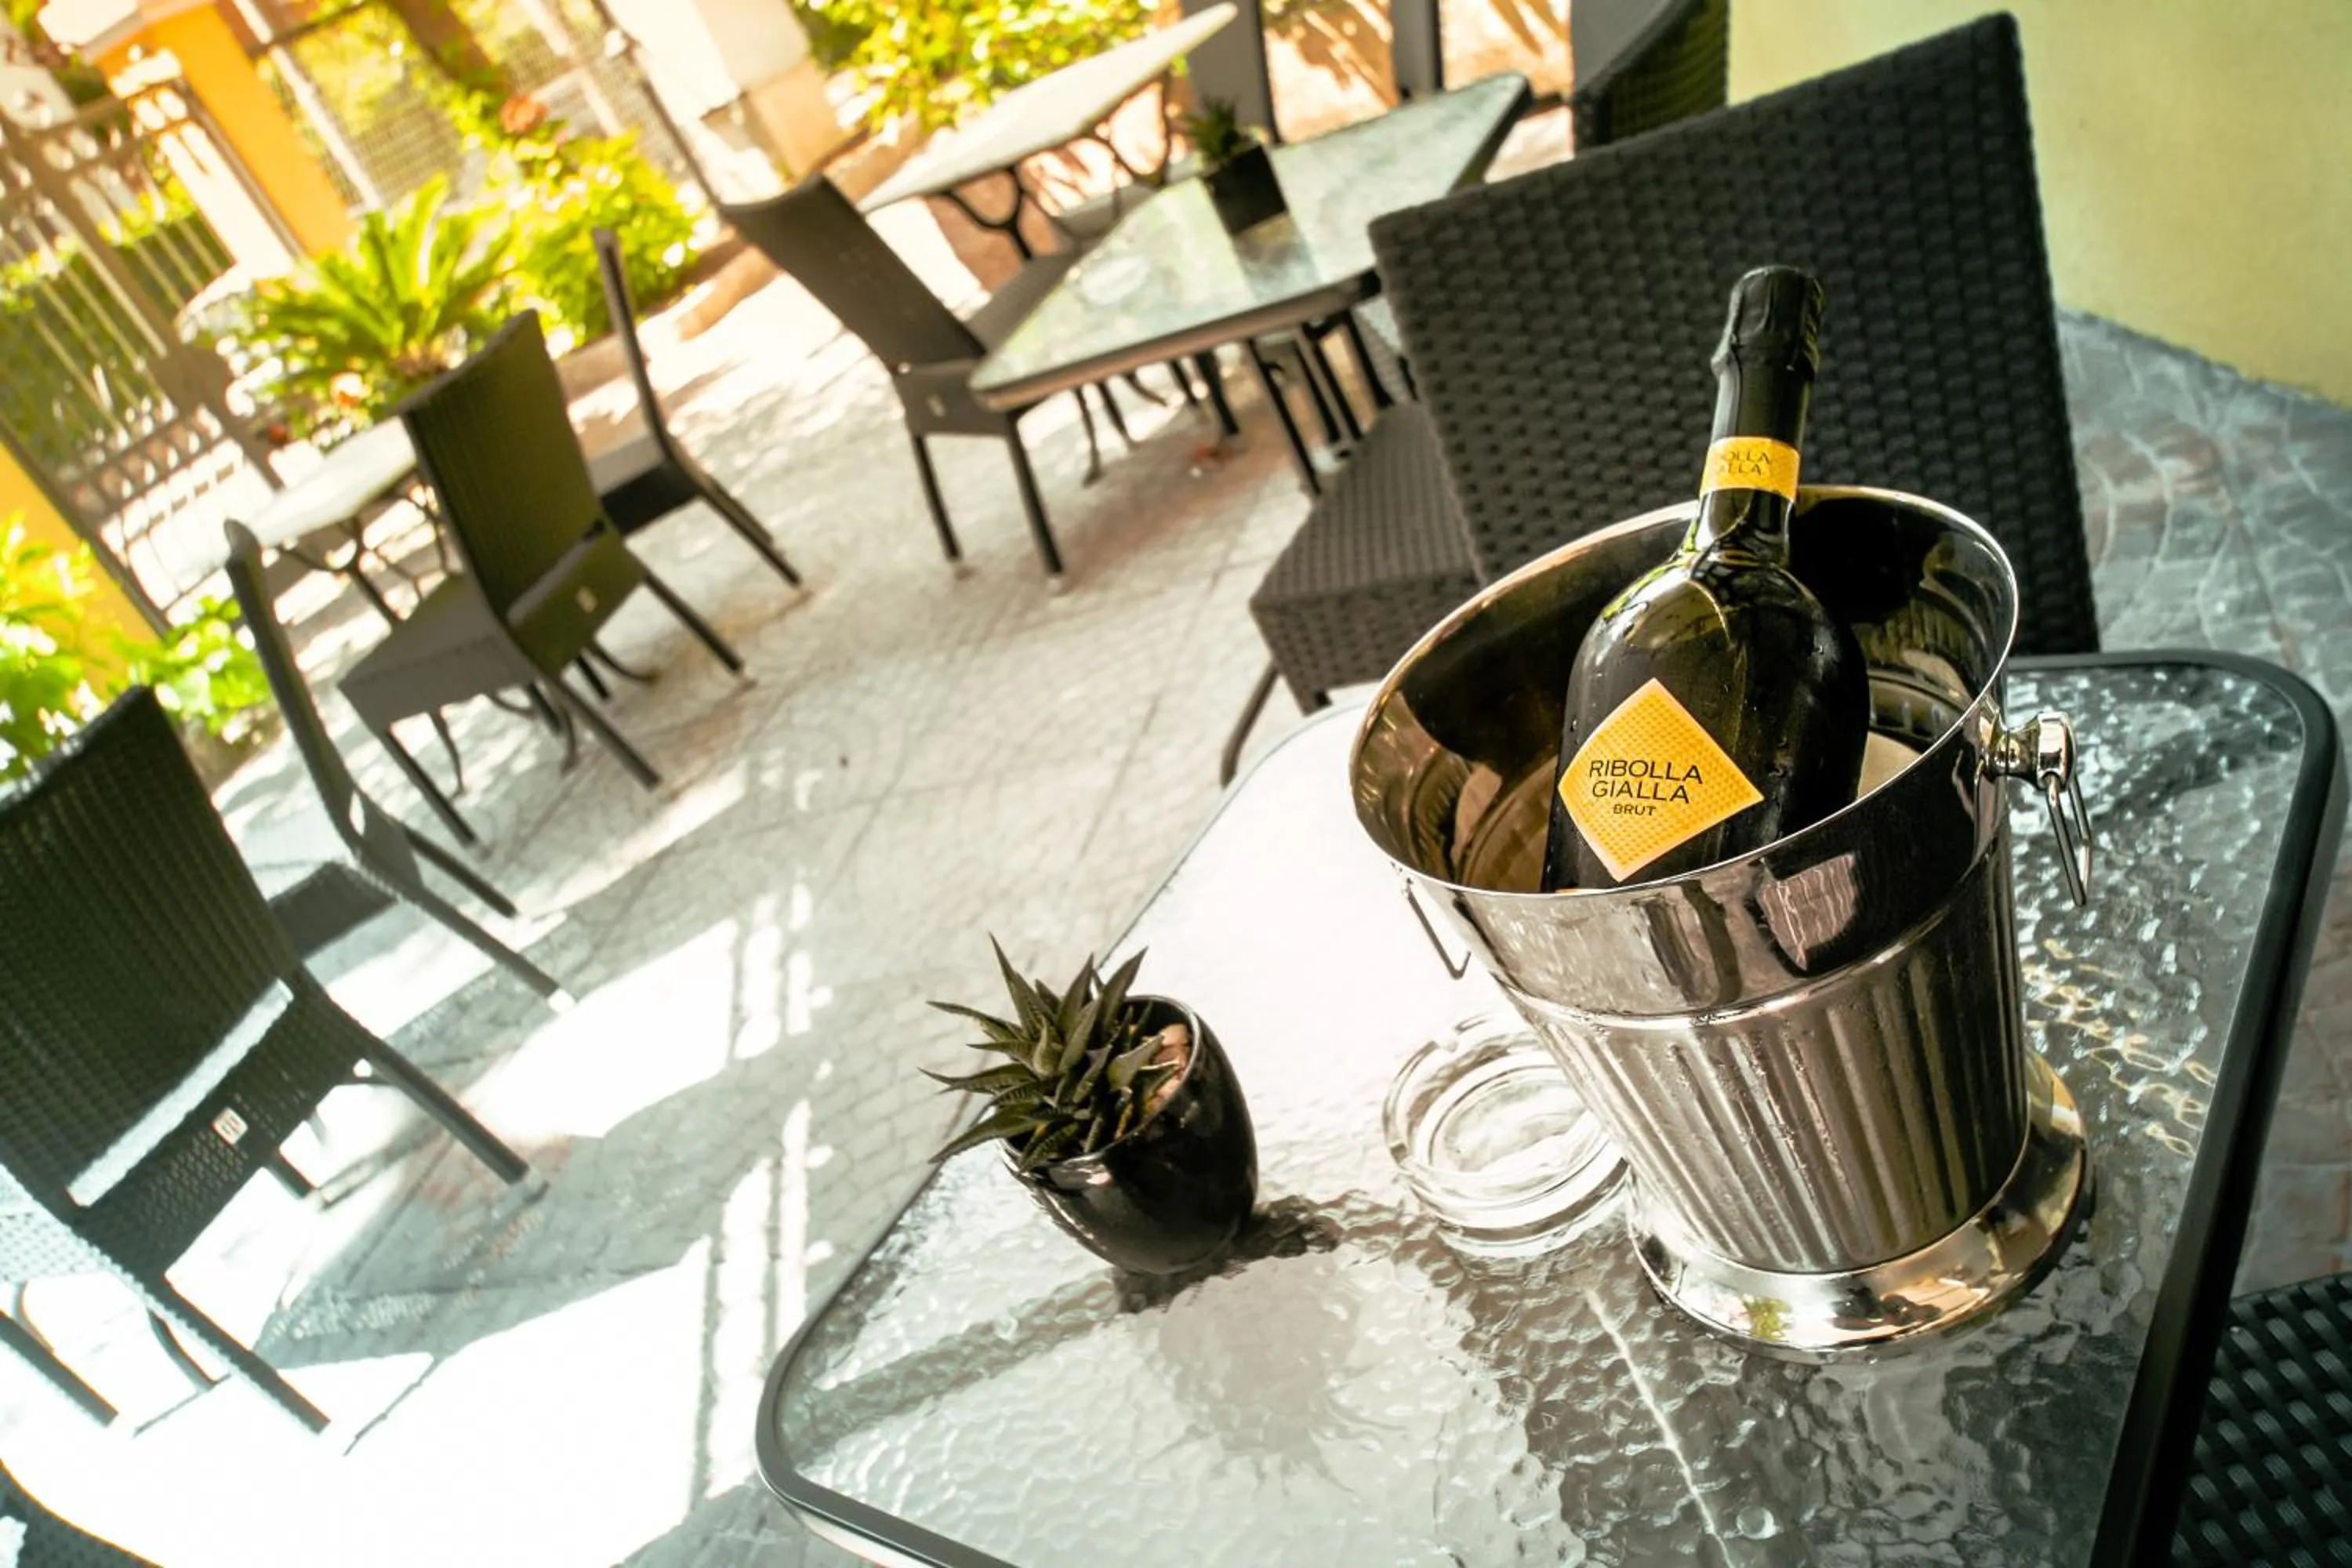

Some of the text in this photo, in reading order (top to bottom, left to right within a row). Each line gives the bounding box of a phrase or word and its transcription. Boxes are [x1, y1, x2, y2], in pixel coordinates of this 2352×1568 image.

[1589, 760, 1703, 785] RIBOLLA
[1592, 780, 1690, 804] GIALLA
[1613, 804, 1657, 816] BRUT
